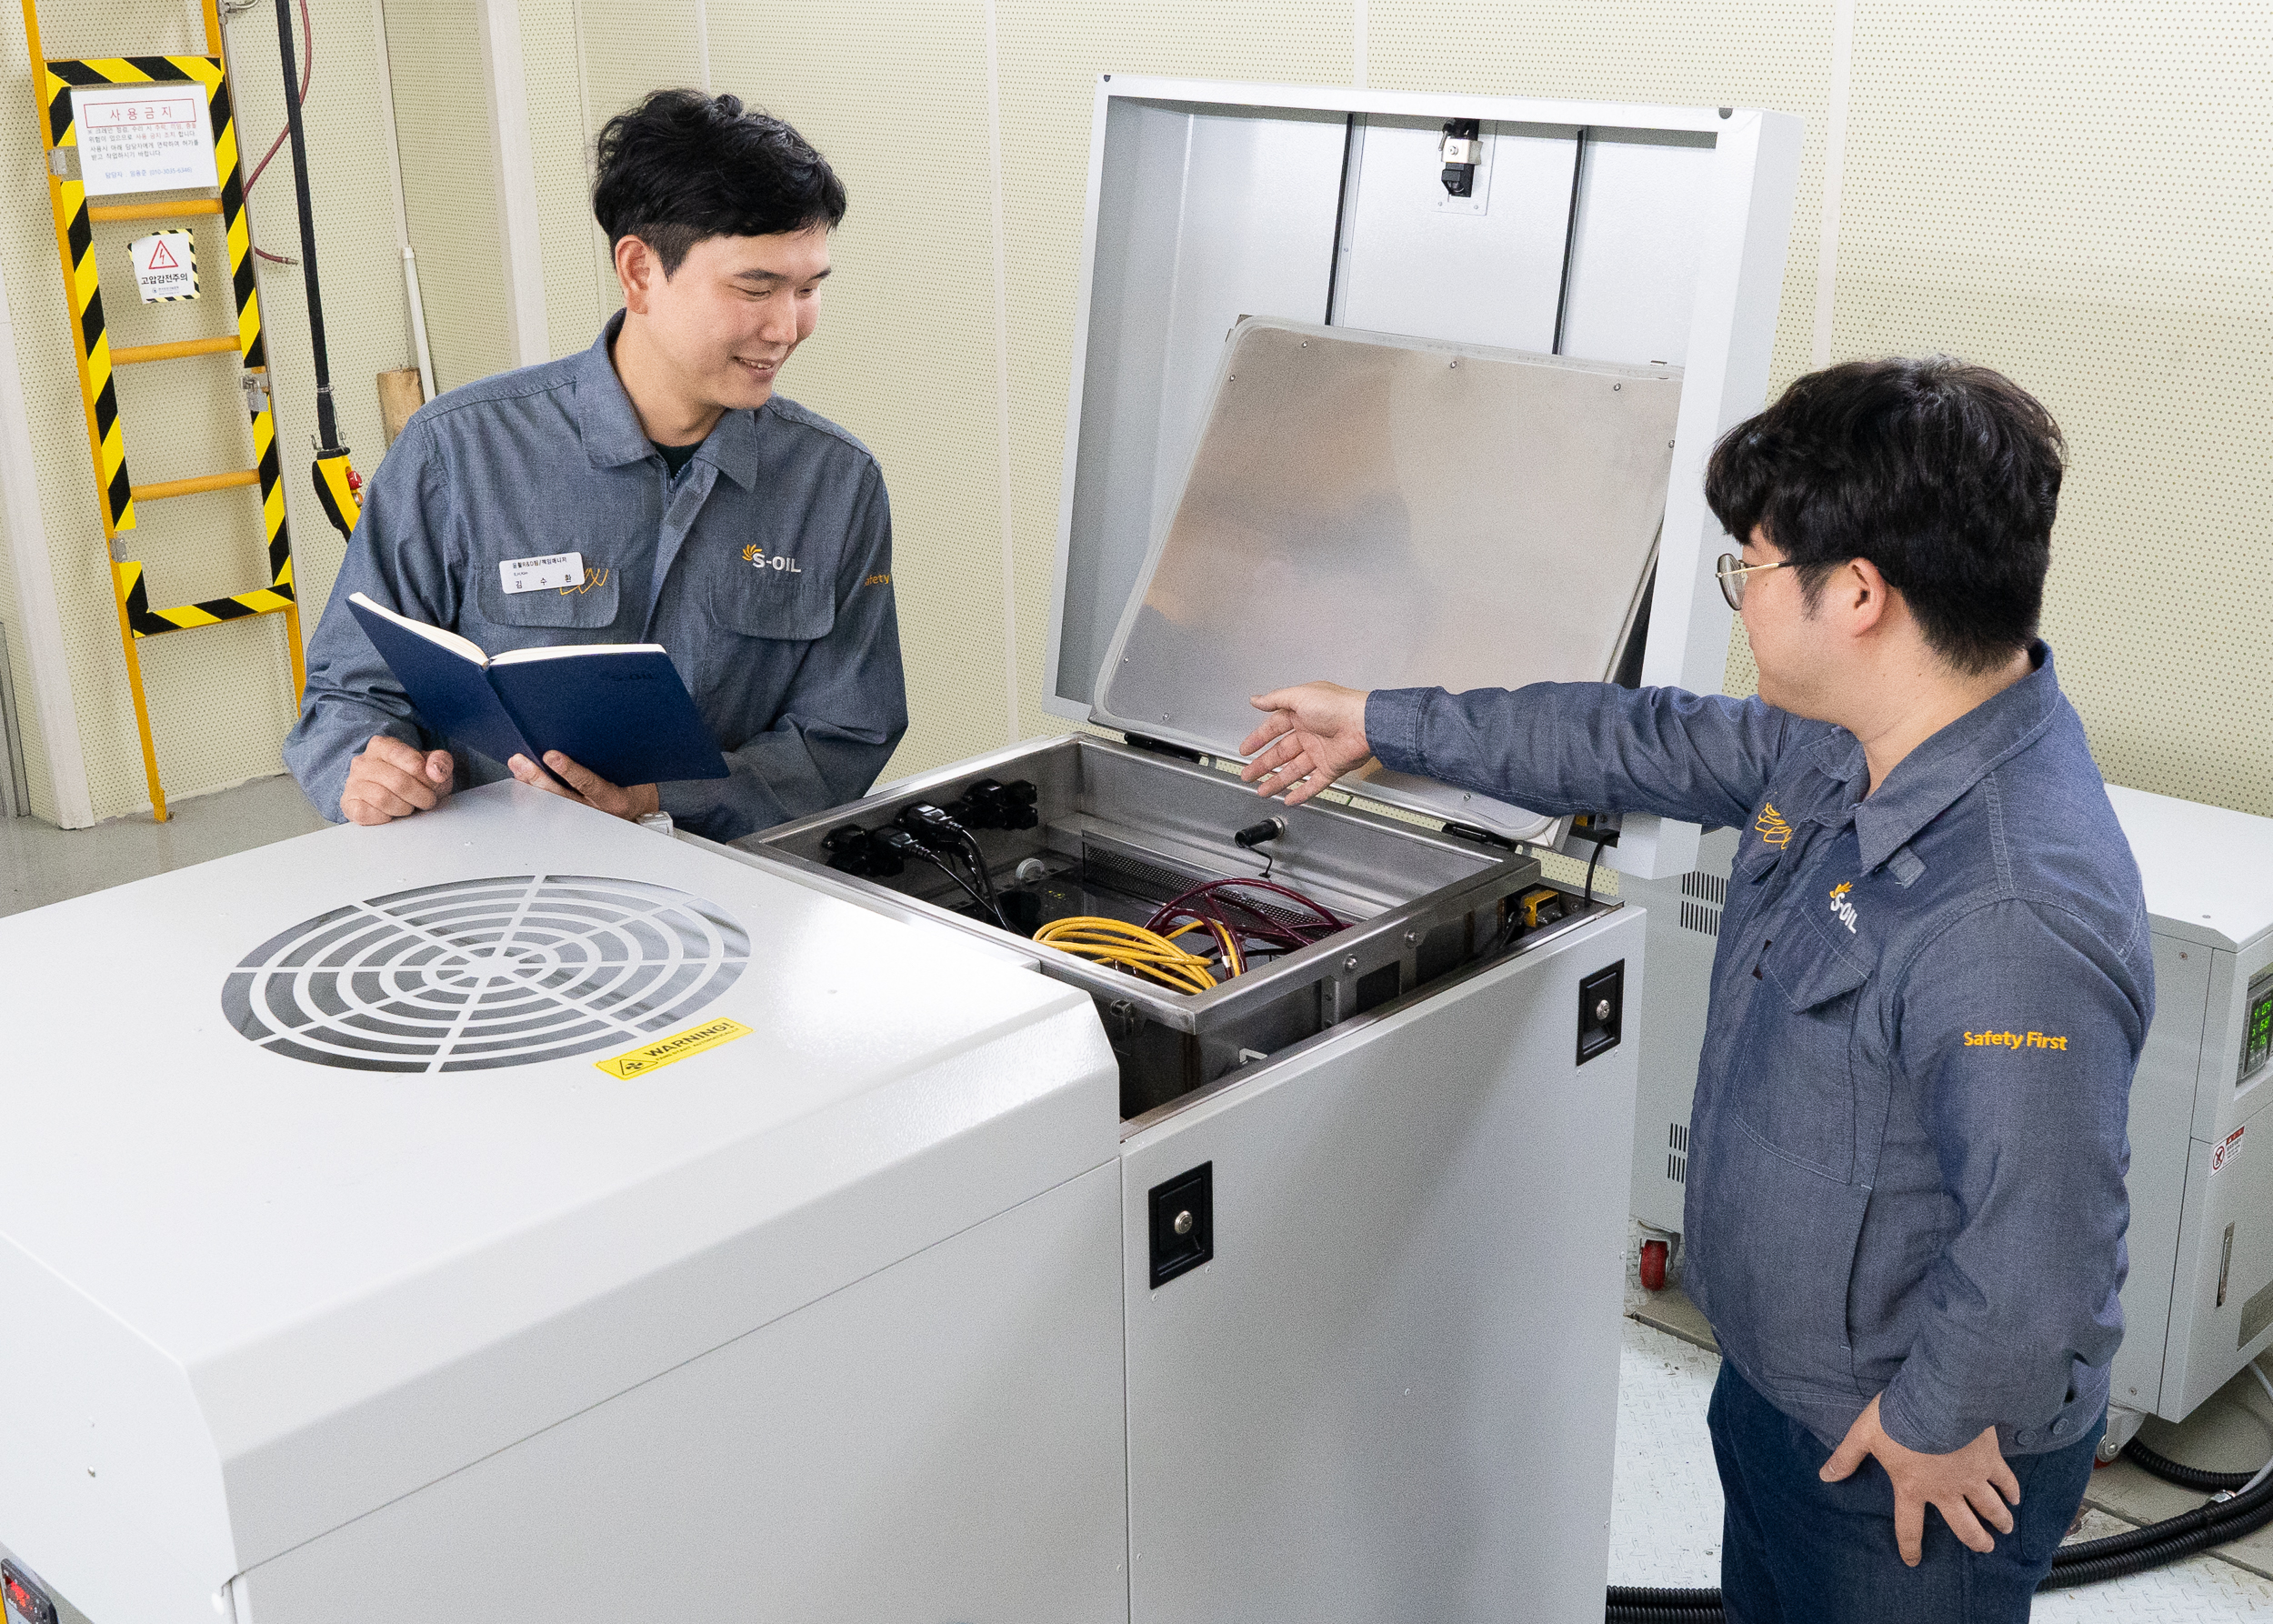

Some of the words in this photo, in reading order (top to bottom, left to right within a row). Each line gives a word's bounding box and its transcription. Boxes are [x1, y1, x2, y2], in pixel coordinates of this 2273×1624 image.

[141, 273, 188, 285] 고압감전주의
[752, 552, 802, 573] S-OIL
[865, 574, 890, 586] afety
[1830, 892, 1858, 934] S-OIL
[643, 1022, 735, 1057] WARNING!
[1963, 1029, 2024, 1050] Safety
[2026, 1030, 2068, 1051] First
